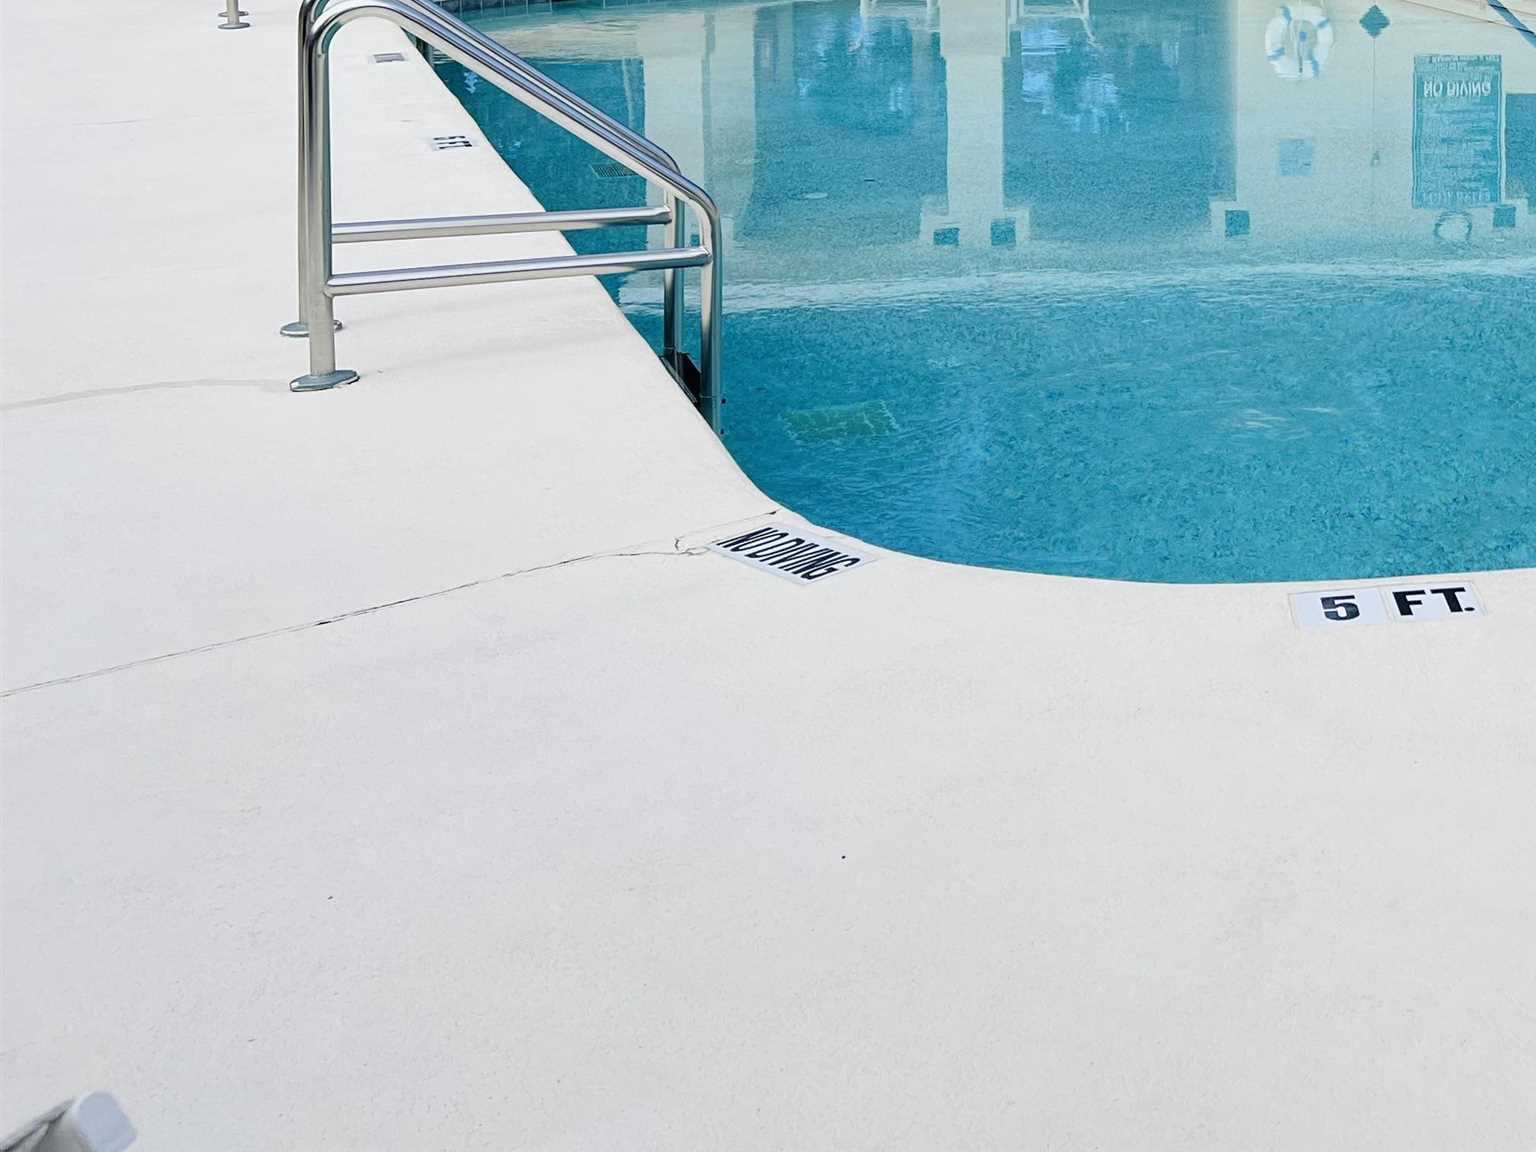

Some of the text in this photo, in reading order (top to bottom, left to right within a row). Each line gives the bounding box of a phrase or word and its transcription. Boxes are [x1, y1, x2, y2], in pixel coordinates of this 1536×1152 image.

[715, 527, 861, 580] NO DIVING
[1320, 586, 1475, 622] 5 FT.
